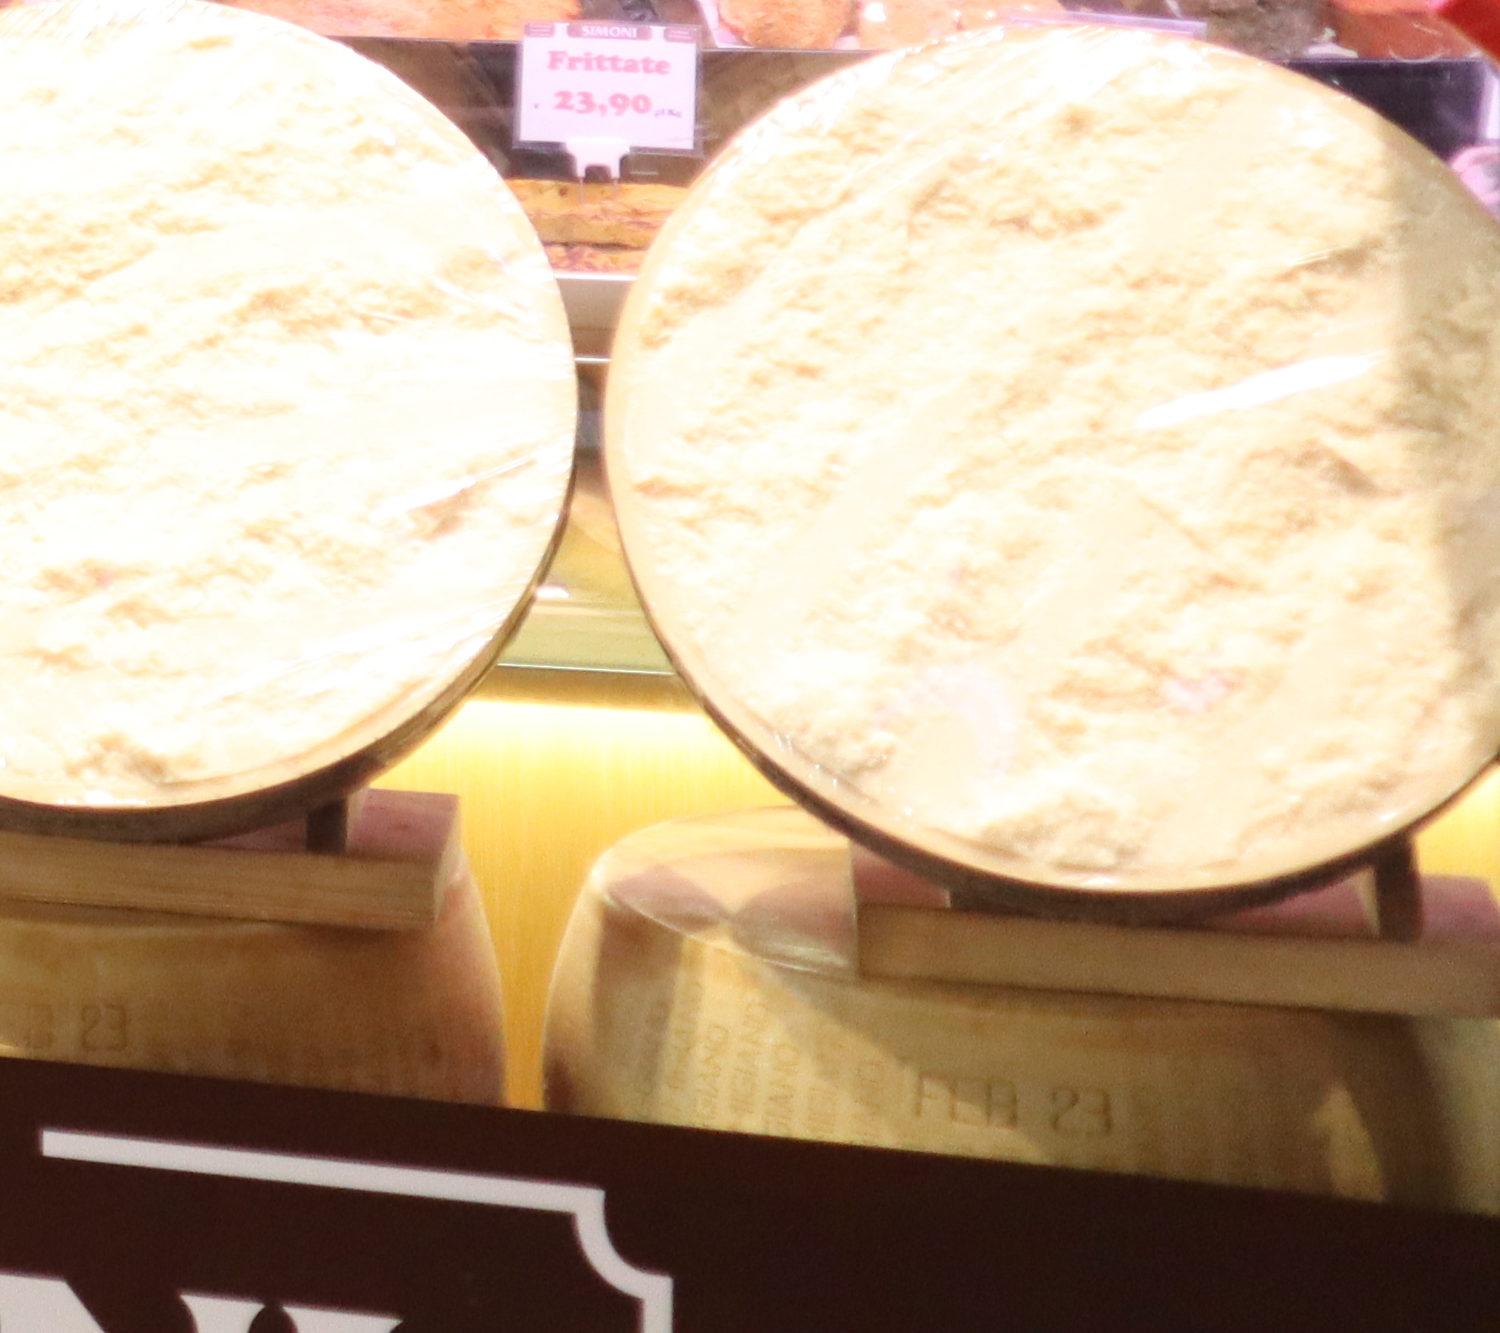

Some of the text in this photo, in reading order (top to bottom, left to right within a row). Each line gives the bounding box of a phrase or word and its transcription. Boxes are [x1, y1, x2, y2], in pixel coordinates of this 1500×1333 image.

[581, 24, 638, 39] SIMONI
[547, 50, 672, 75] Frittate
[553, 90, 652, 118] 23,90
[1051, 1089, 1112, 1135] 23
